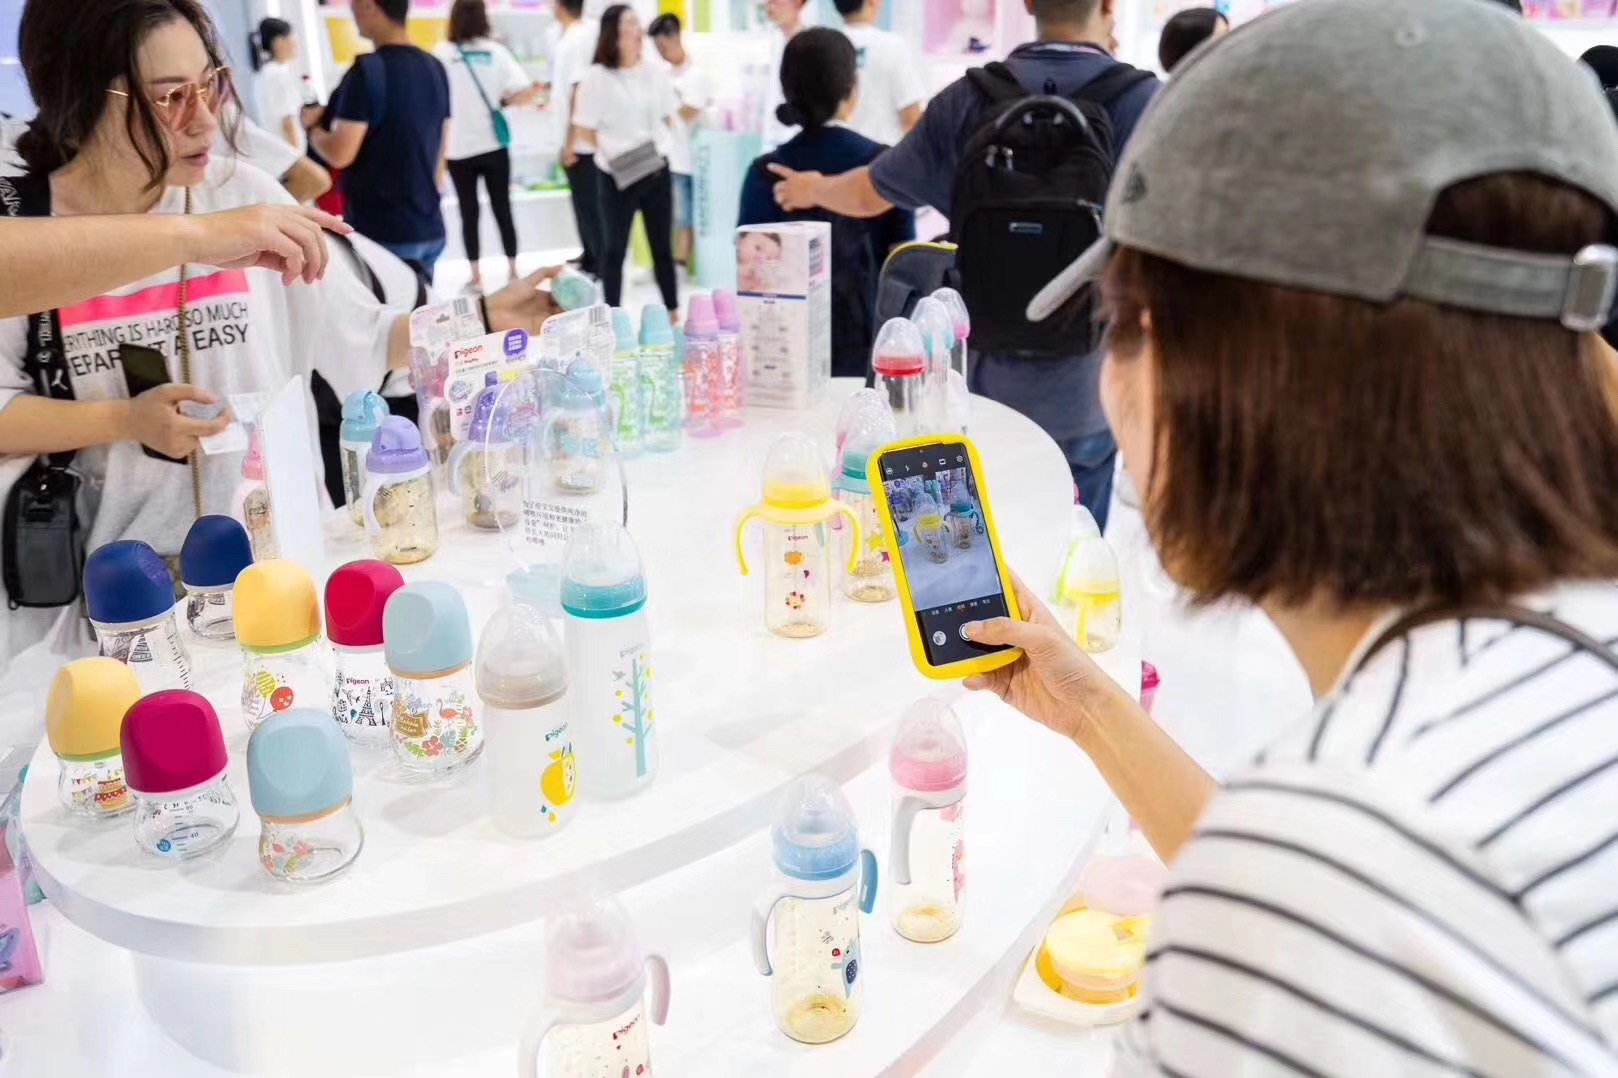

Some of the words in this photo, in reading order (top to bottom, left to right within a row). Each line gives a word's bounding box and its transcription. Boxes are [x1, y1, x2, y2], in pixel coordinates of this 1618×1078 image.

[127, 323, 143, 342] IS
[206, 302, 248, 321] MUCH
[192, 323, 248, 351] EASY
